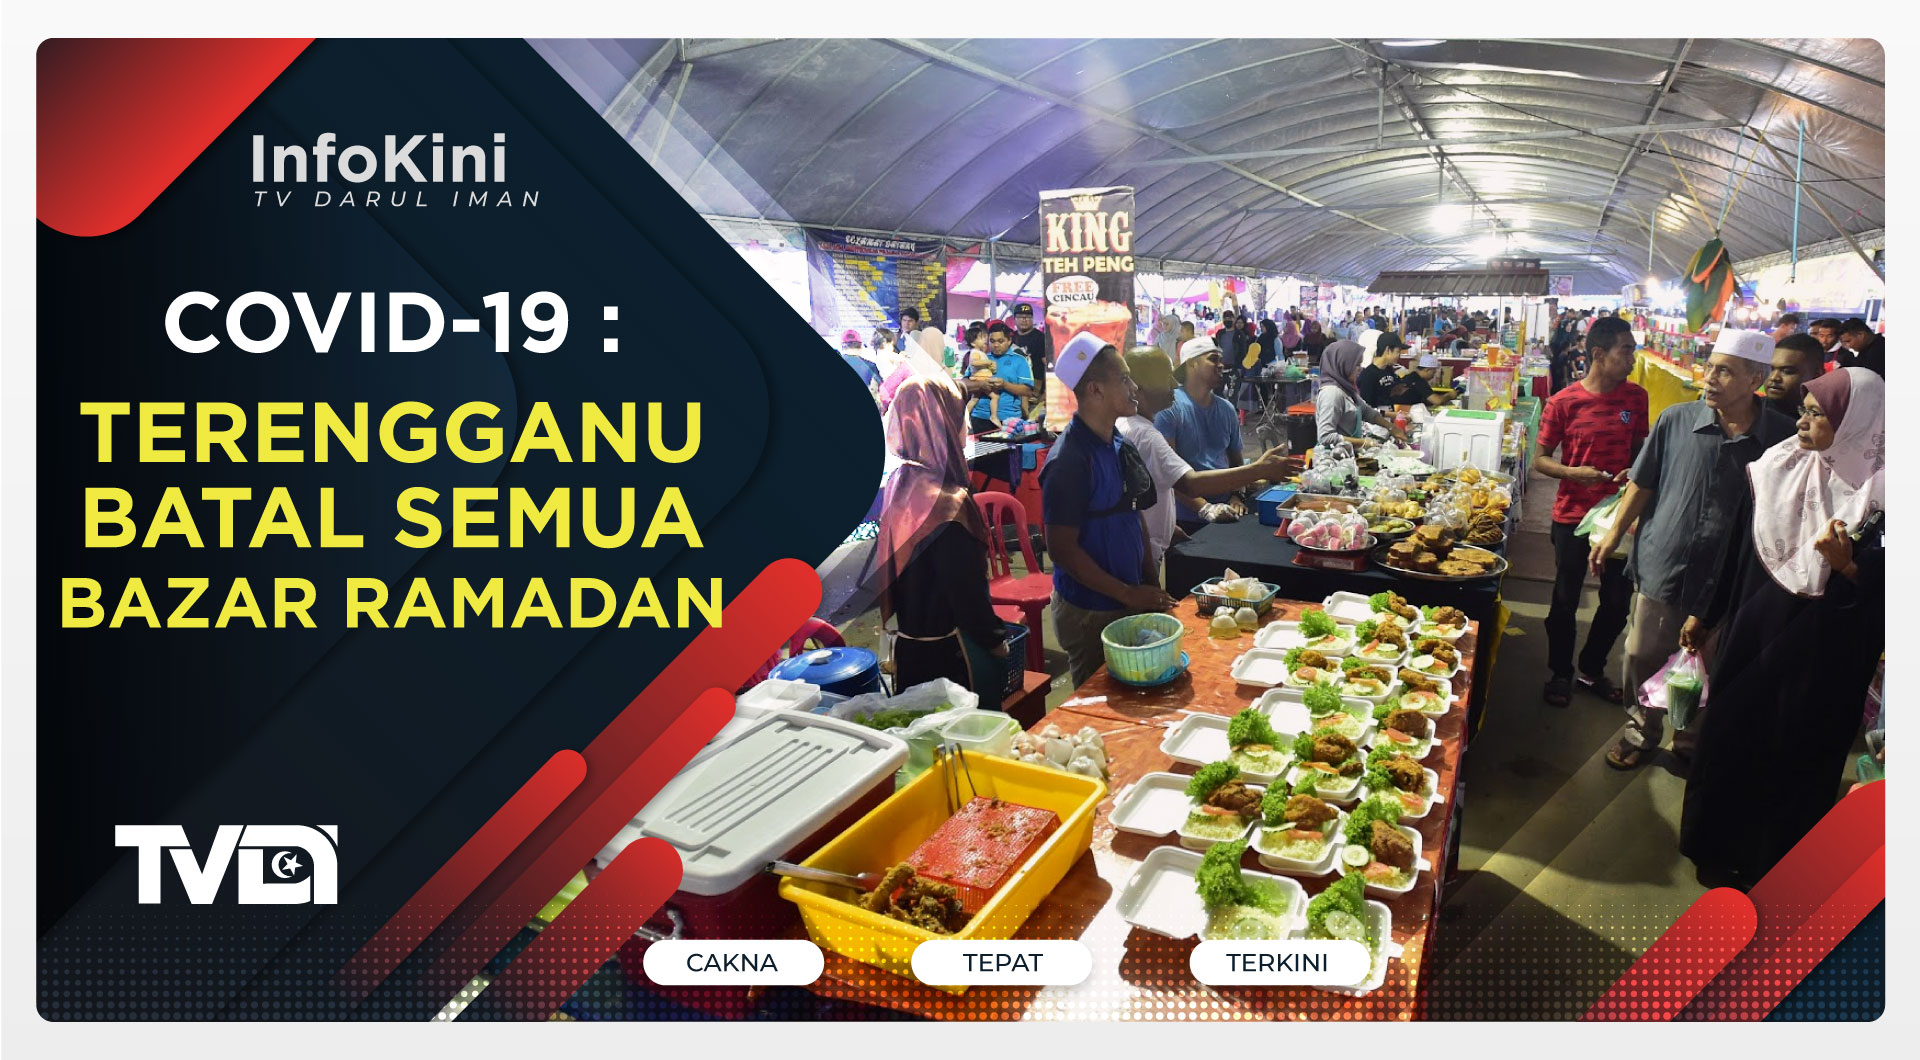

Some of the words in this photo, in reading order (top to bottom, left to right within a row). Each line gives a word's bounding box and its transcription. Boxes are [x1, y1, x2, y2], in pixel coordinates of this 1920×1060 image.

[1045, 211, 1132, 253] KING
[1043, 257, 1078, 273] TEH
[1083, 256, 1134, 273] PENG
[1052, 281, 1093, 294] FREE
[1053, 293, 1095, 302] CINCAU
